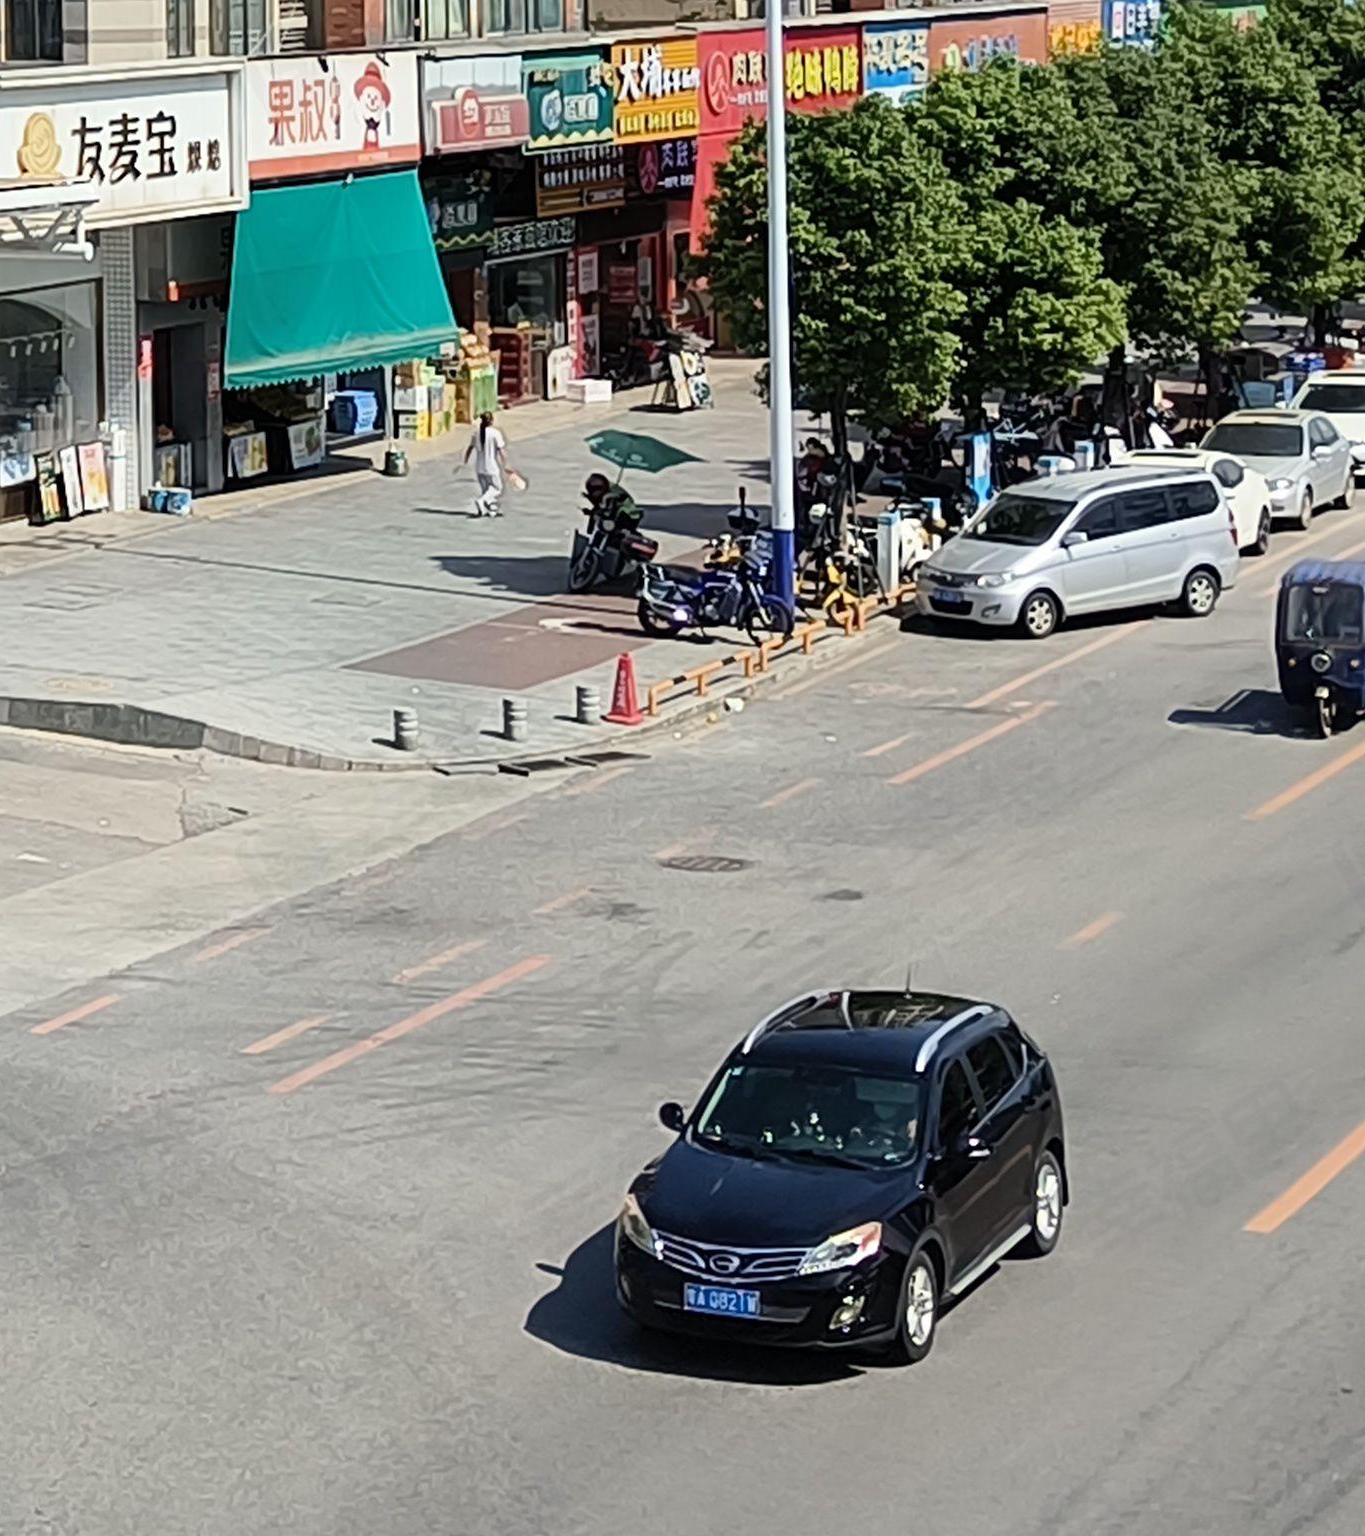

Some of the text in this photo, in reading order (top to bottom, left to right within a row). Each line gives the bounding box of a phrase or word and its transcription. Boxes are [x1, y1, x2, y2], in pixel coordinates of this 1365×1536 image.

[268, 78, 328, 145] 果叔
[70, 110, 178, 185] 友麦宝
